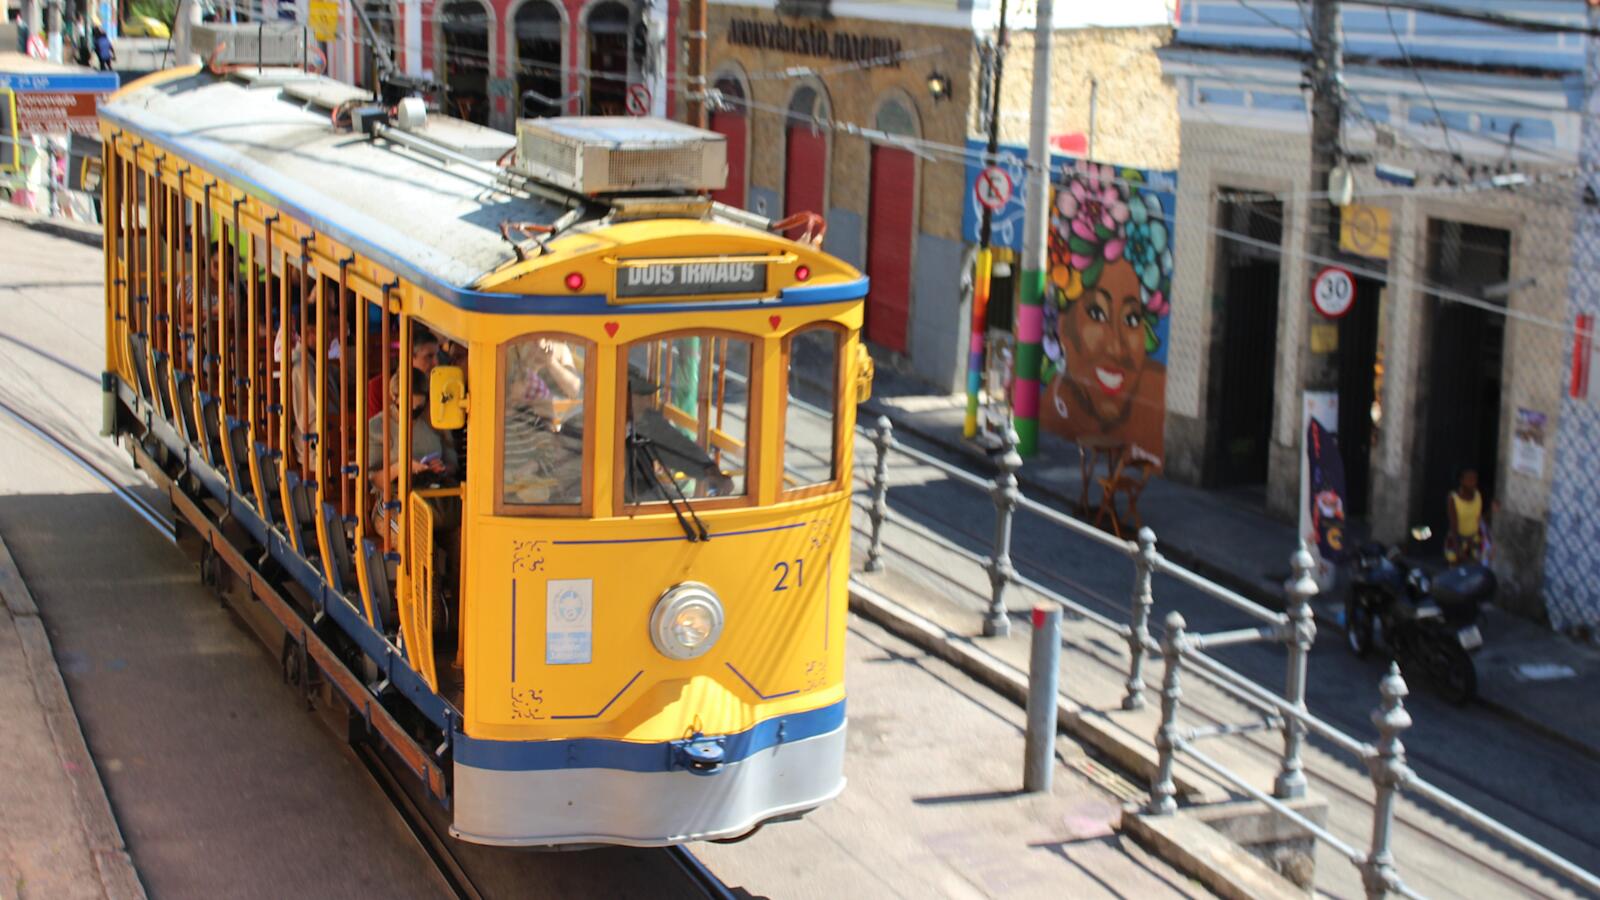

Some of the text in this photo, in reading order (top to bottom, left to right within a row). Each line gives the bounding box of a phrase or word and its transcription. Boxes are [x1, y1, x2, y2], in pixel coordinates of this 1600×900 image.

[628, 263, 674, 286] DOIS
[1320, 275, 1349, 300] 30
[773, 558, 804, 592] 21
